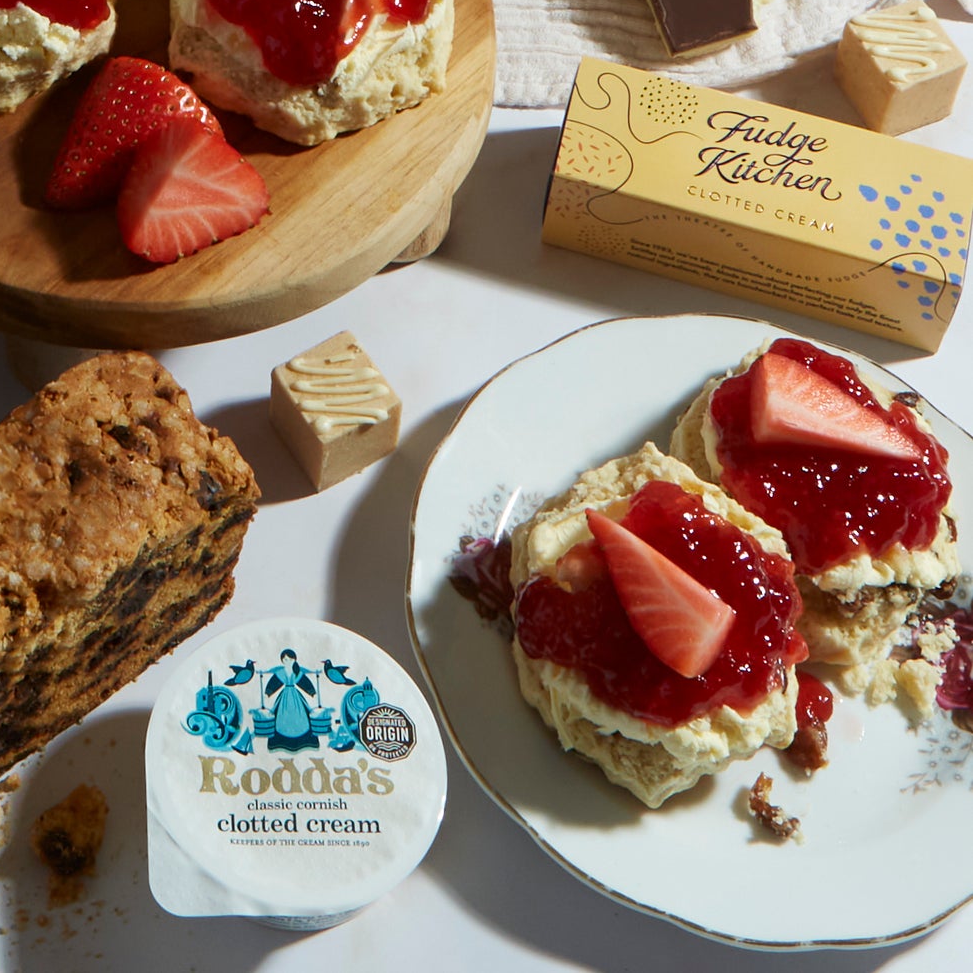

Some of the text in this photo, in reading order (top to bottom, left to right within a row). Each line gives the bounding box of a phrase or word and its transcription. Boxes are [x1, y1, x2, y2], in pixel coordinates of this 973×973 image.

[707, 110, 828, 167] Fudge
[694, 147, 842, 201] Kitchen
[687, 185, 836, 234] CLOTTED CREAM
[367, 718, 406, 727] DESIGNATED
[366, 727, 409, 741] ORIGIN
[199, 755, 395, 796] Rodda's
[247, 798, 348, 811] classic cornish
[217, 813, 381, 833] clotted cream
[230, 838, 264, 846] KEEPERS
